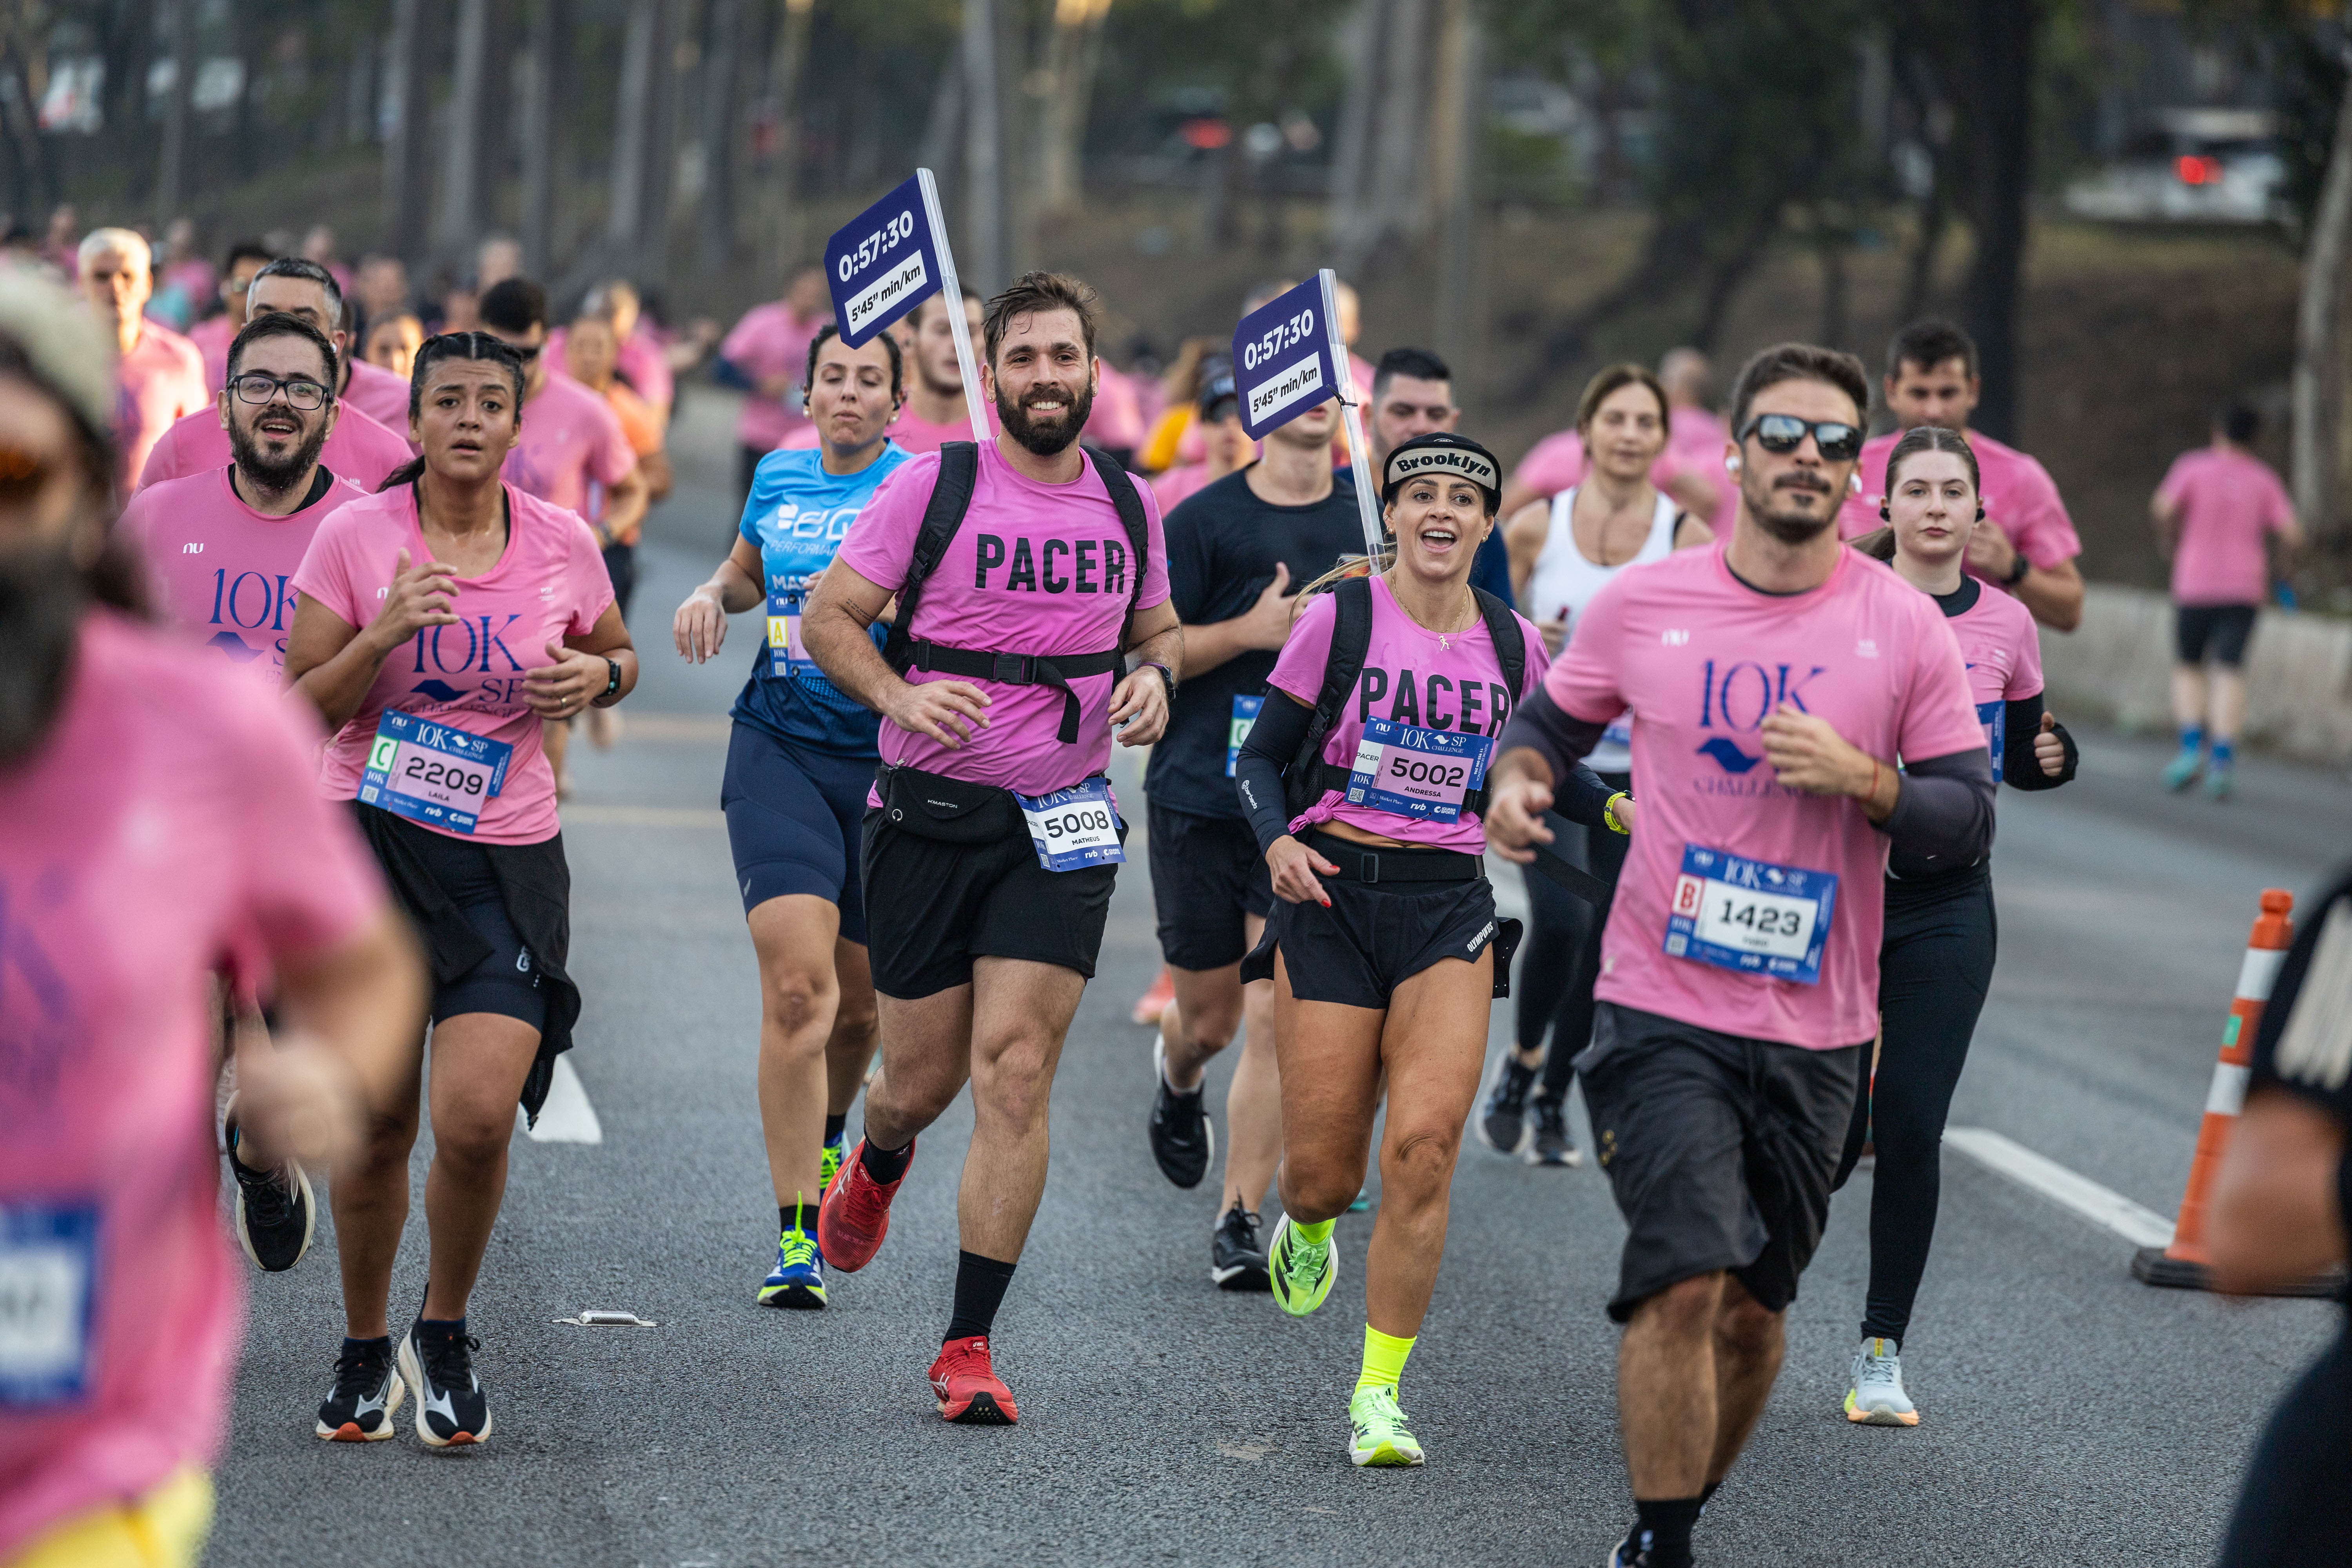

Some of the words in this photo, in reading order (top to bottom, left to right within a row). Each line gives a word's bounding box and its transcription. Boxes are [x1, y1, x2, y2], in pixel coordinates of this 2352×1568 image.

[839, 211, 913, 282] 0:57:30
[881, 265, 920, 302] min/km
[1245, 309, 1313, 370] 0:57:30
[1281, 367, 1317, 397] min/km
[1396, 452, 1491, 476] Brooklyn
[182, 543, 204, 554] nu
[975, 534, 1125, 594] PACER
[208, 568, 298, 631] 10K
[412, 614, 524, 674] 10K
[773, 621, 783, 643] A
[774, 649, 786, 658] 10K
[1360, 667, 1510, 740] PACER
[1699, 659, 1828, 734] 10K
[416, 723, 451, 750] 10K
[471, 740, 488, 753] SP
[1376, 723, 1391, 732] nu
[1400, 728, 1433, 750] 10K
[1451, 736, 1466, 747] SP
[377, 742, 390, 766] C
[1356, 752, 1379, 762] PACER
[1432, 745, 1464, 753] CHALLENGE
[367, 771, 385, 784] 10K
[406, 757, 483, 795] 2209
[1353, 774, 1371, 784] 10K
[1390, 757, 1464, 788] 5002
[428, 791, 450, 802] LAILA
[1080, 783, 1090, 793] SP
[1404, 786, 1441, 797] ANDRESSA
[1044, 810, 1109, 838] 5008
[1035, 840, 1046, 850] 10K
[1072, 836, 1100, 845] MATHEUS
[1085, 850, 1098, 858] rvb
[1680, 882, 1696, 909] B
[1719, 898, 1801, 936] 1423
